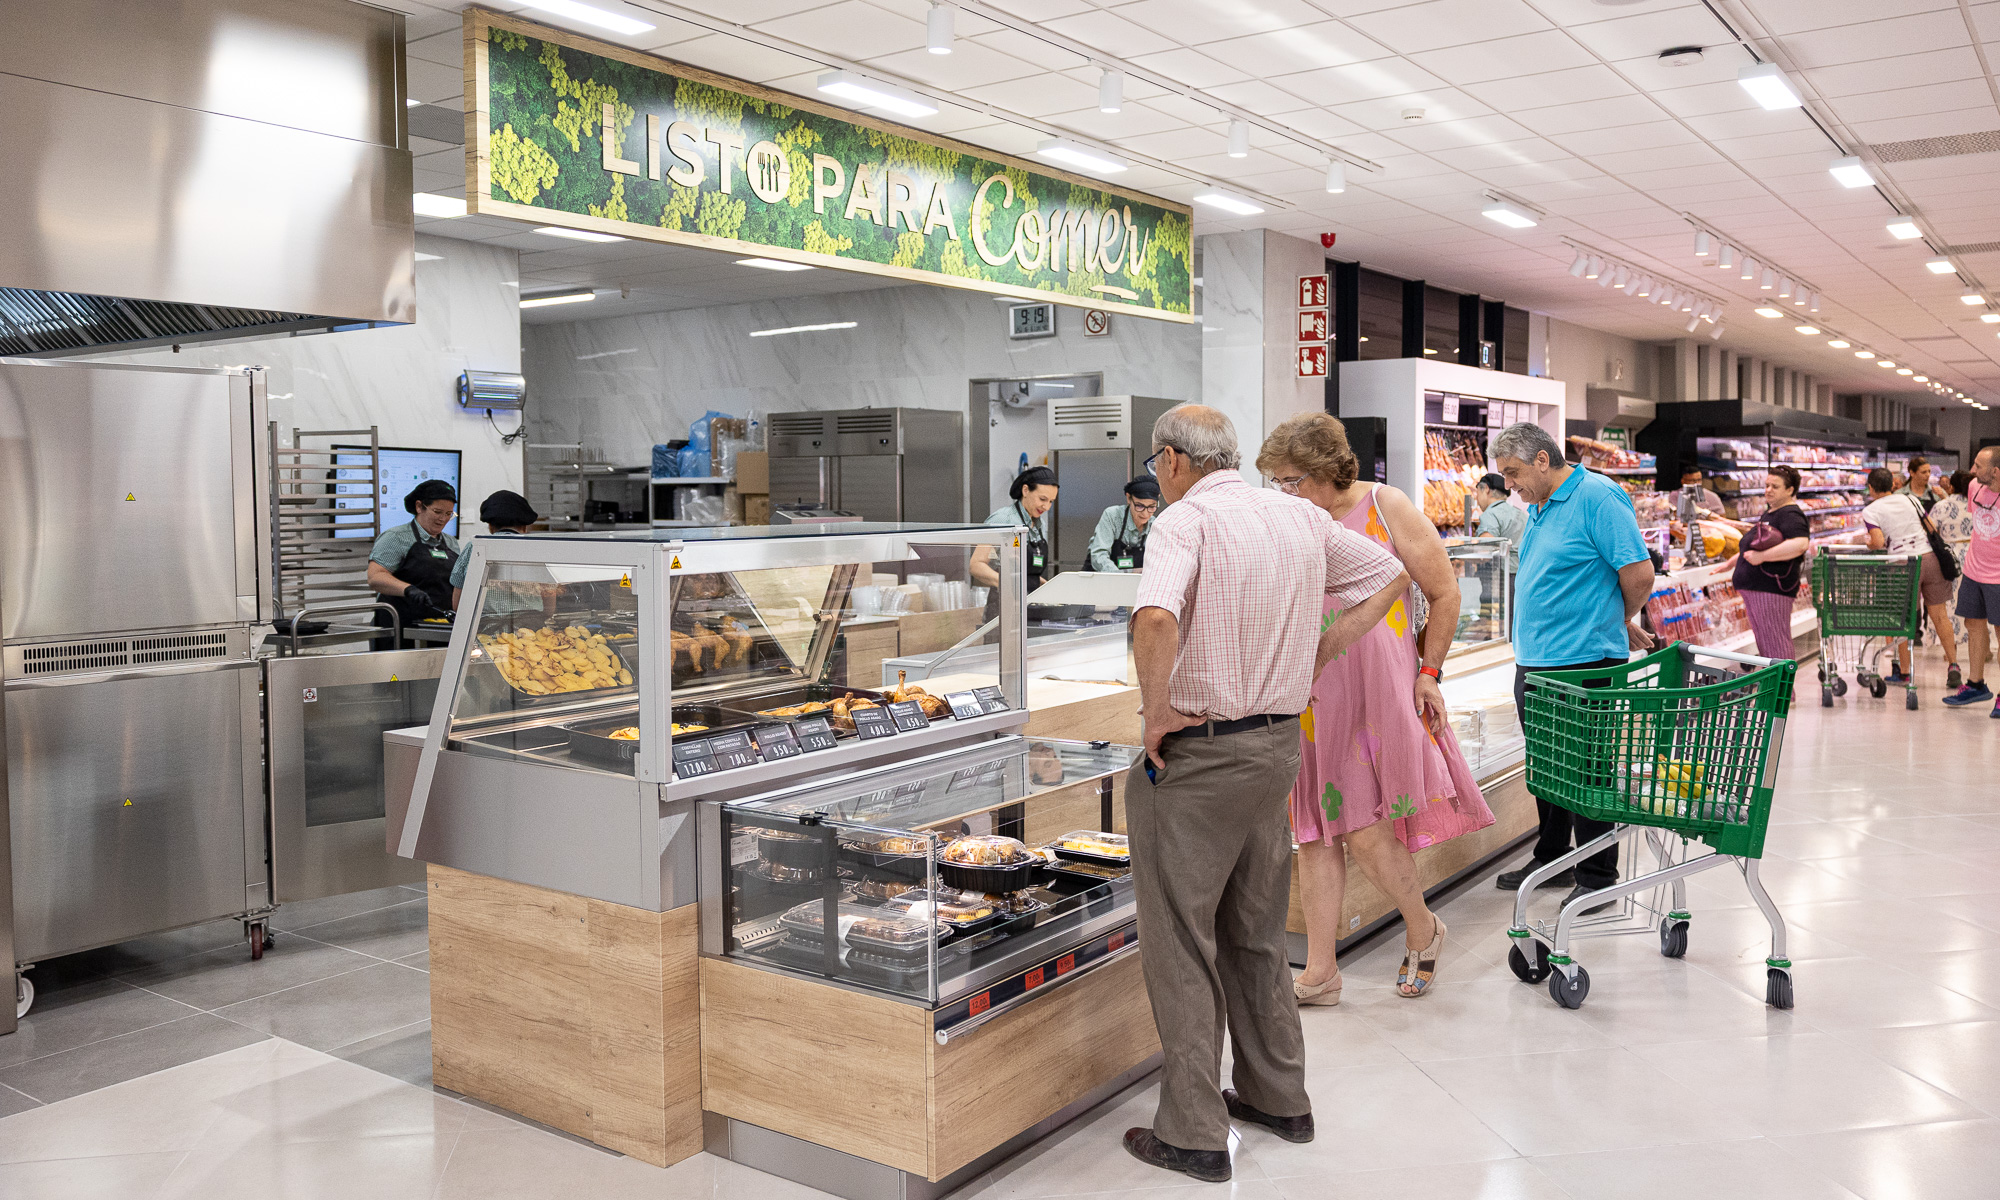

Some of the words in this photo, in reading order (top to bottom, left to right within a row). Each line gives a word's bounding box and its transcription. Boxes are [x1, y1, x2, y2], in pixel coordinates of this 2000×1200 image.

[602, 102, 790, 204] LISTO
[813, 152, 958, 240] PARA
[971, 174, 1149, 276] Comer
[1021, 308, 1044, 325] 9:19
[684, 761, 707, 775] 12,00
